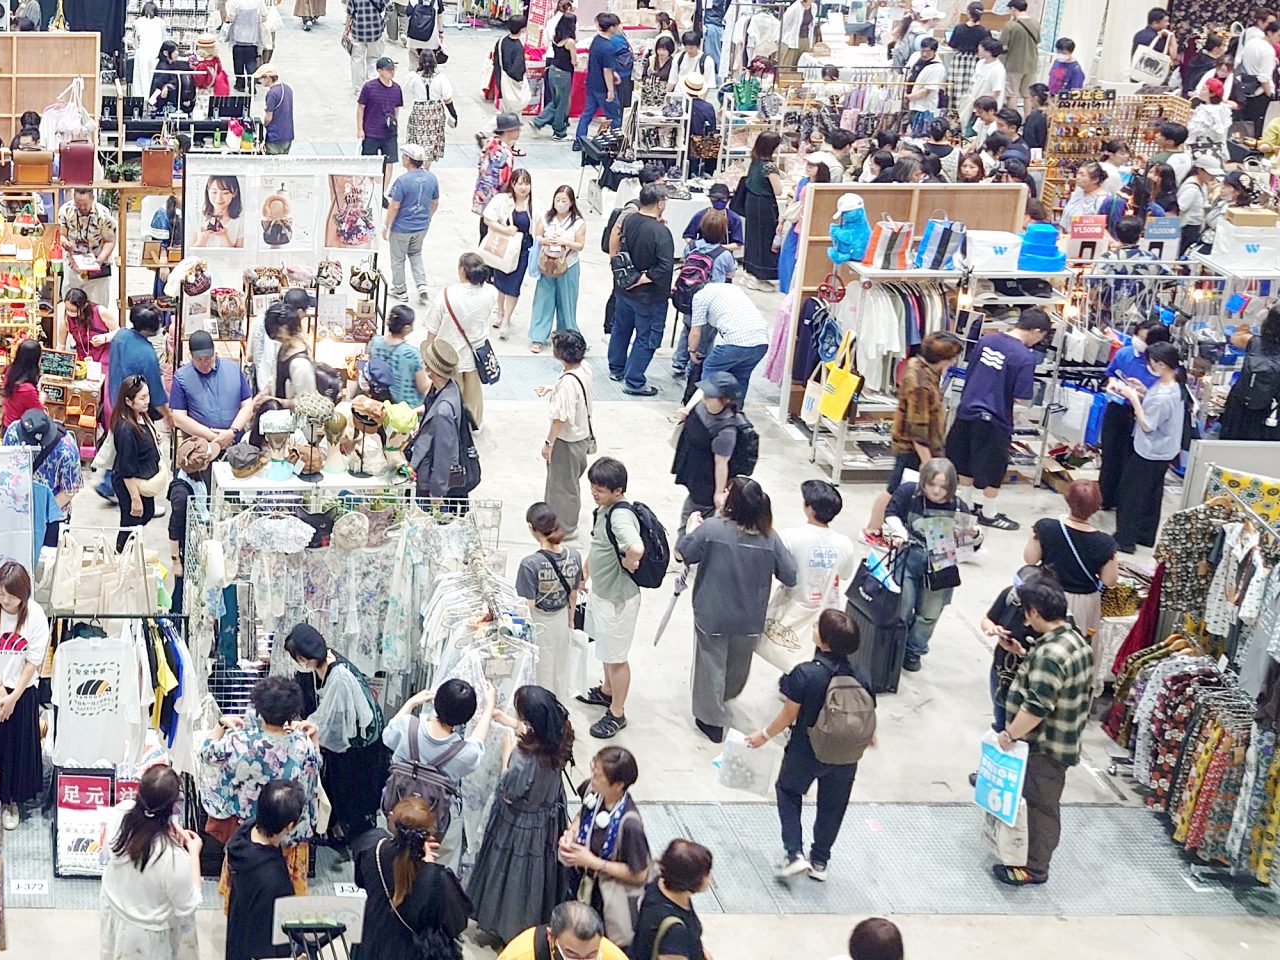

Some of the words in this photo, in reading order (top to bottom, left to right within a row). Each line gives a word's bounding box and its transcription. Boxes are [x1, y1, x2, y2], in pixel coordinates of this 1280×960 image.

[62, 785, 105, 805] 足元
[988, 789, 1013, 817] 61
[16, 883, 45, 891] J-372
